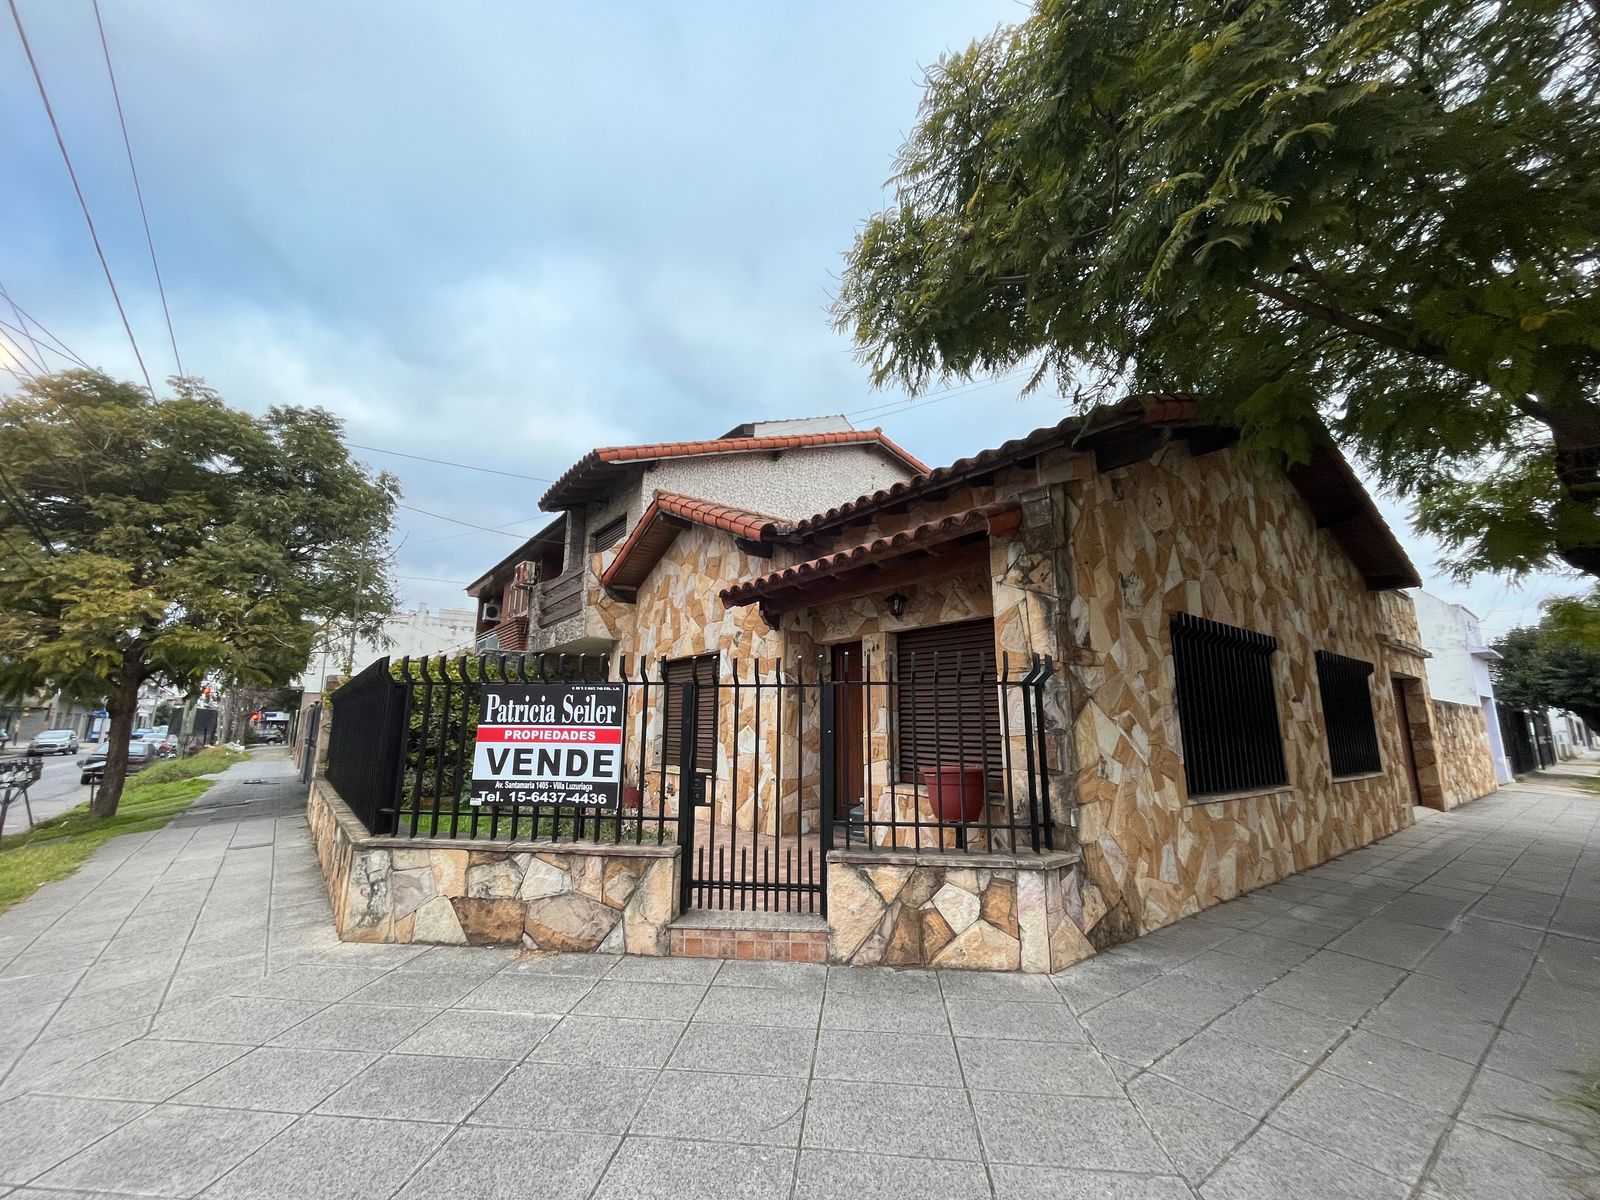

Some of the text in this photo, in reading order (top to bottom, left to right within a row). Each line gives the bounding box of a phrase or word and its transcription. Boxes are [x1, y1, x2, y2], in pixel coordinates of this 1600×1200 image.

[484, 693, 617, 724] Patricia Seiler
[504, 730, 596, 741] PROPIEDADES
[486, 748, 614, 778] VENDE
[495, 781, 503, 789] Av.
[553, 782, 565, 790] Villa
[566, 782, 593, 792] Luzuriaga
[479, 791, 504, 802] Tel.
[509, 791, 607, 804] 15-6437-4436
